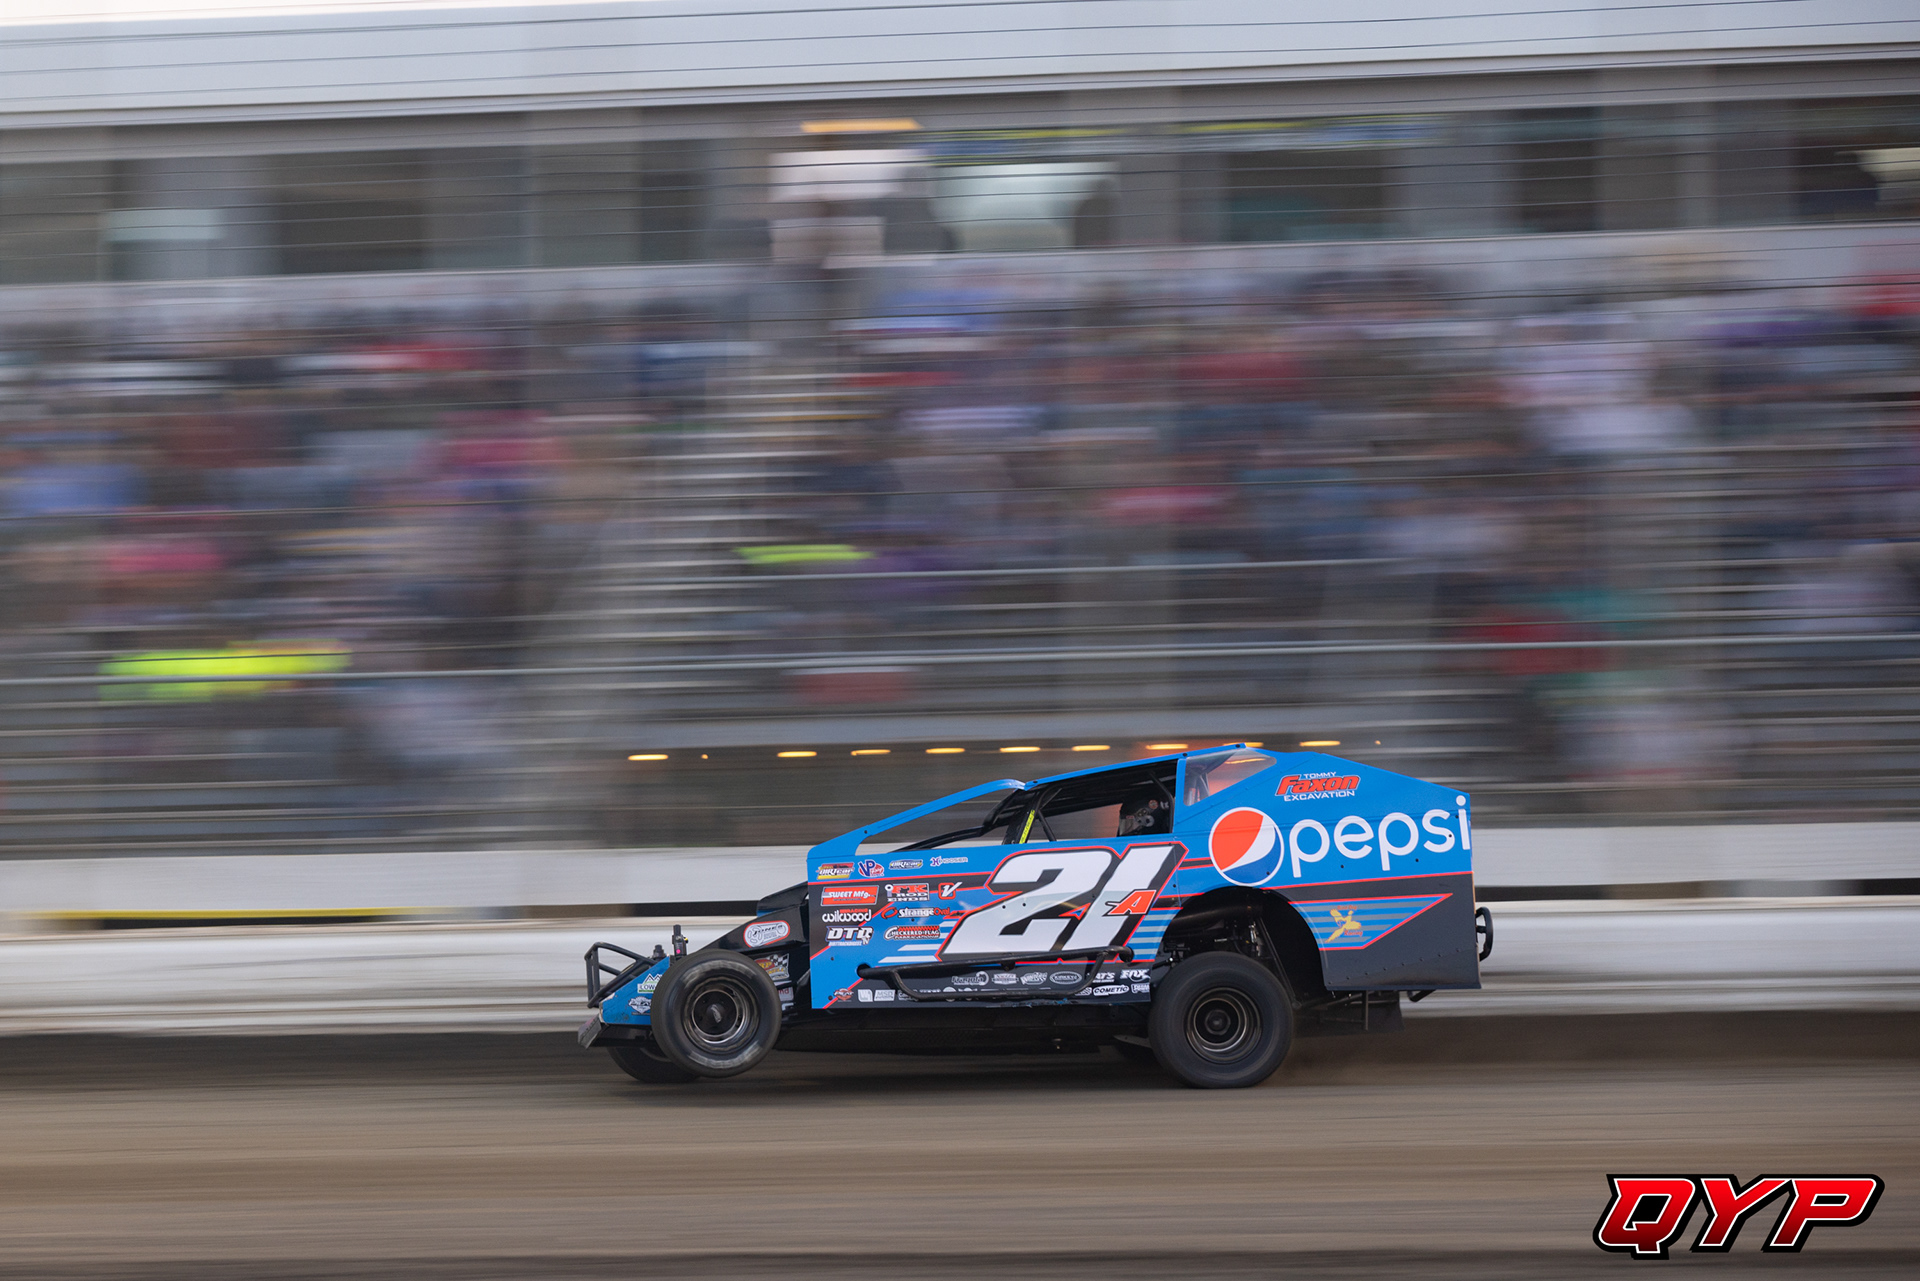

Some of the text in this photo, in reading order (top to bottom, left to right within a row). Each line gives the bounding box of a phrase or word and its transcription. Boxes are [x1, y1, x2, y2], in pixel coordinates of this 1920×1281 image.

[1276, 775, 1360, 795] Faxon
[1283, 790, 1355, 802] EXCAVATION
[1289, 795, 1471, 878] pepsi
[858, 860, 875, 877] VP
[943, 846, 1174, 953] 21
[822, 909, 872, 922] wilwood
[1120, 969, 1150, 981] FOX
[1094, 986, 1128, 994] COMETIC
